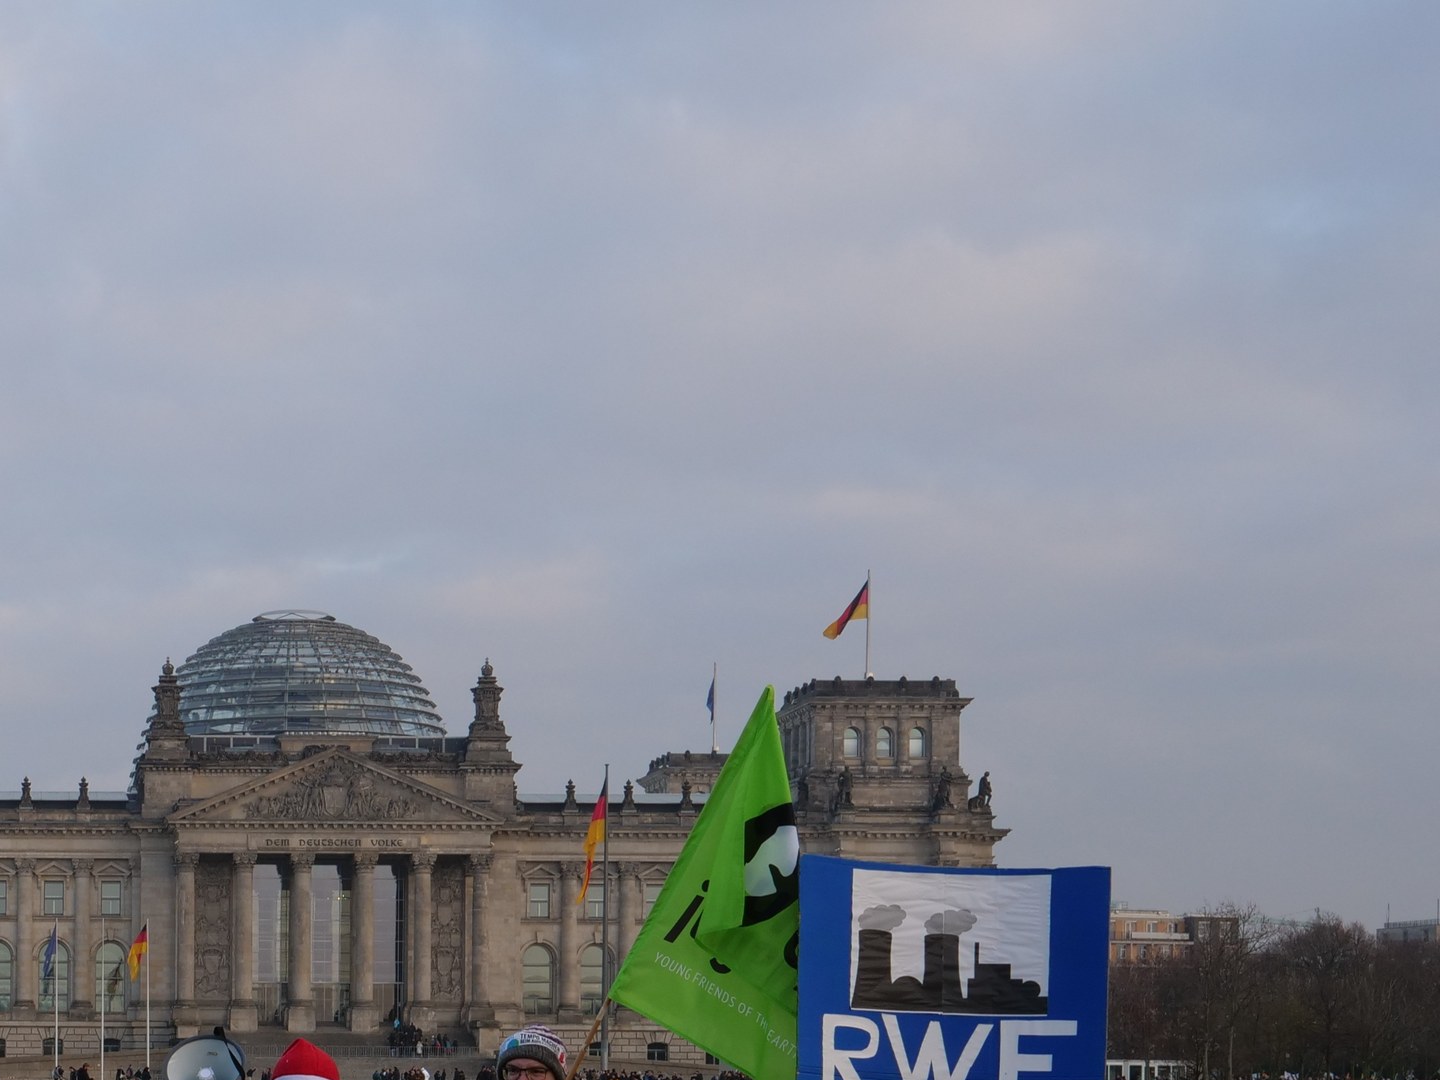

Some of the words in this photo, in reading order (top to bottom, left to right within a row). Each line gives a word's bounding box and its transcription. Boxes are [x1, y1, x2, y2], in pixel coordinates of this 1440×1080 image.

[266, 839, 290, 847] DEM
[299, 838, 362, 847] DEUTSCHEN
[371, 839, 403, 847] VOLKE
[654, 951, 692, 981] YOUNG
[692, 972, 736, 1008] FRIENDS
[737, 1002, 753, 1017] OF
[766, 1029, 797, 1058] EART
[520, 1033, 541, 1041] TEMPO
